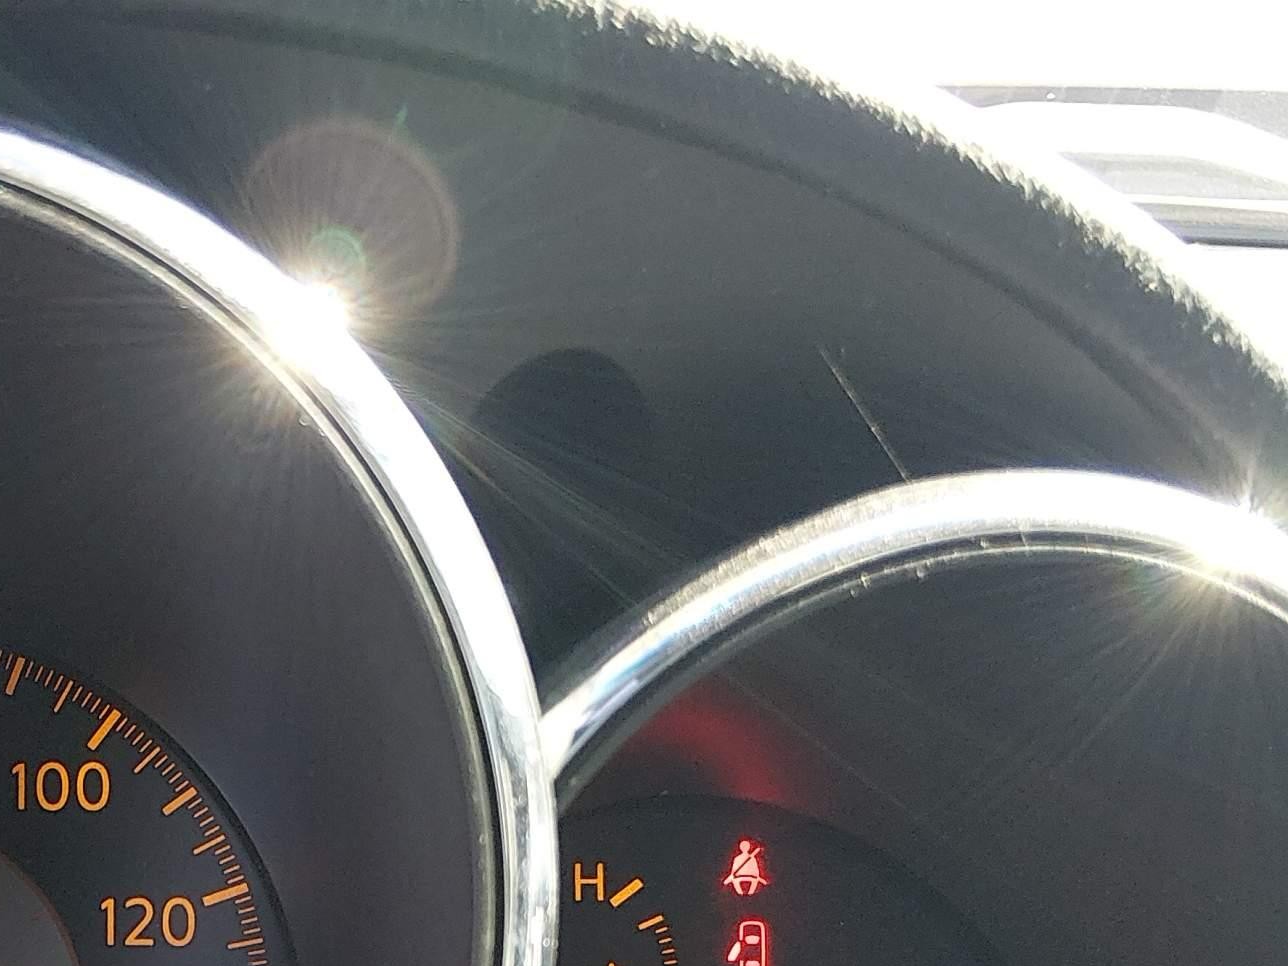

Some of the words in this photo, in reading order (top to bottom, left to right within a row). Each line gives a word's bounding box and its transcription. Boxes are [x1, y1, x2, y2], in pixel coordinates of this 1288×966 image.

[11, 761, 110, 812] 100
[575, 863, 605, 901] H
[100, 896, 196, 947] 120
